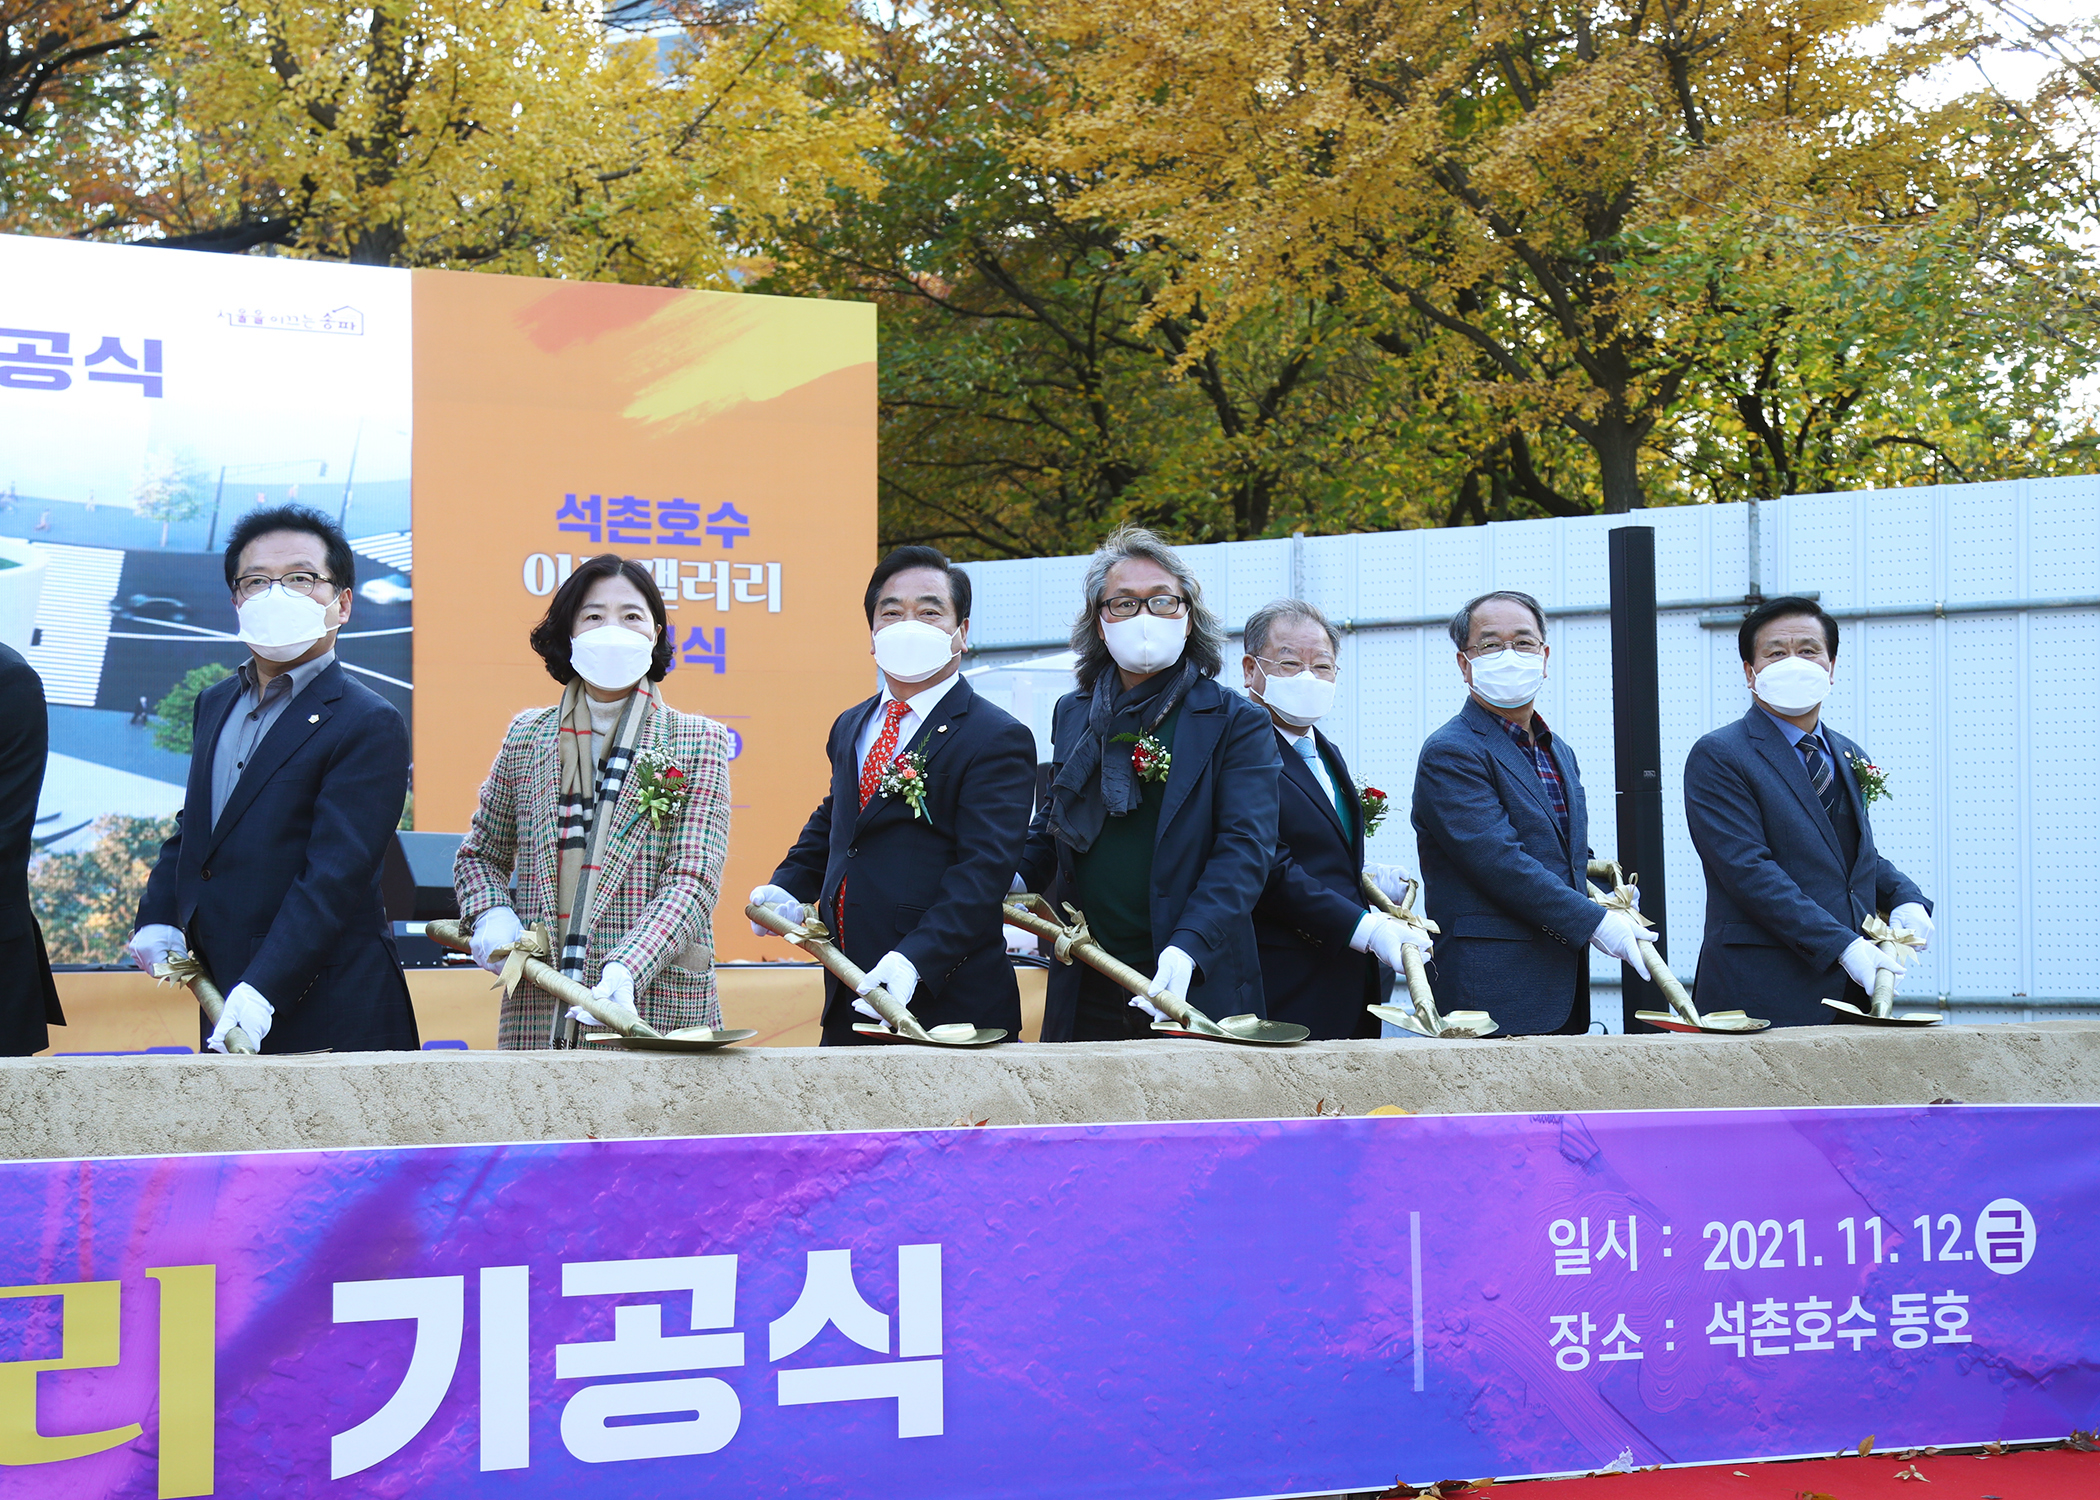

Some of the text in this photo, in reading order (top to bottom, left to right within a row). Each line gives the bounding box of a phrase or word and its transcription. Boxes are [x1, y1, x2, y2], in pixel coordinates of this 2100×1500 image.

[270, 314, 315, 330] 이끄는
[319, 311, 357, 331] 송파
[556, 494, 750, 549] 석촌호수
[1549, 1215, 1639, 1276] 일시
[1703, 1218, 1823, 1271] 2021.
[1838, 1217, 1899, 1265] 11.
[1549, 1311, 1644, 1372] 장소
[1705, 1295, 1877, 1358] 석촌호수
[1889, 1289, 1973, 1350] 동호
[331, 1243, 944, 1480] 기공식
